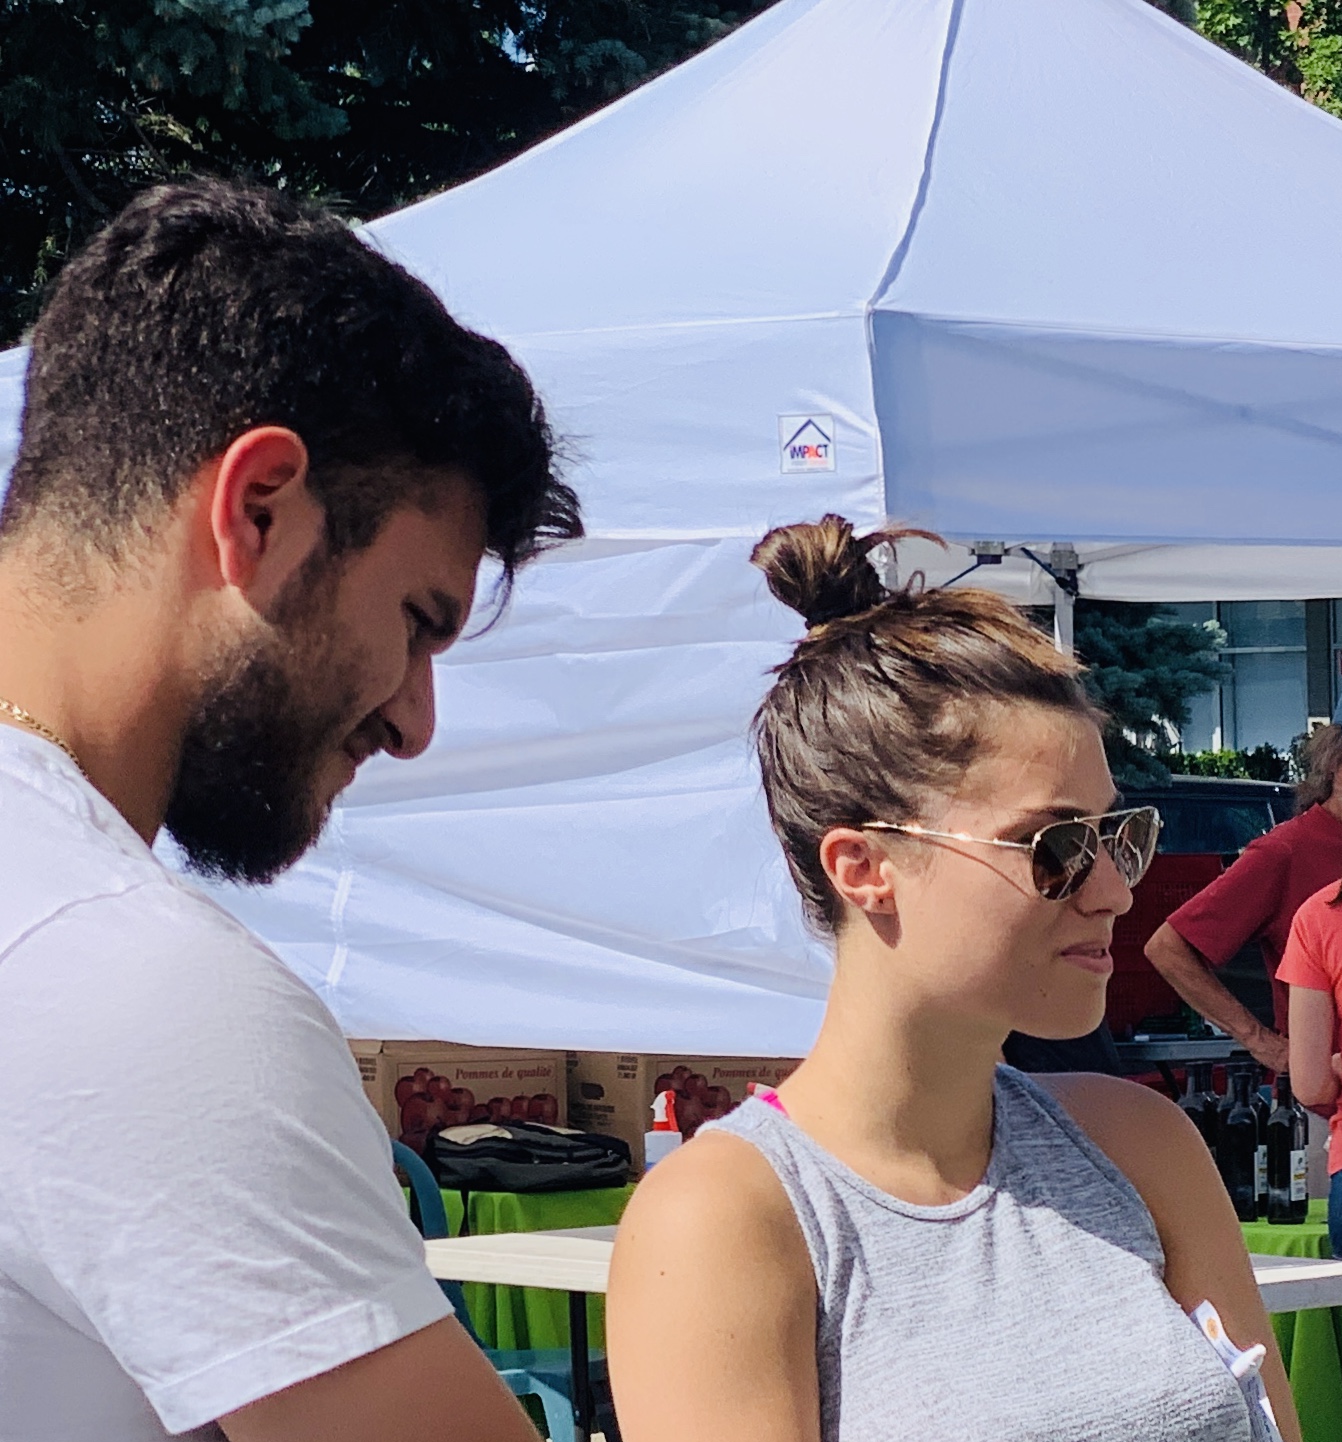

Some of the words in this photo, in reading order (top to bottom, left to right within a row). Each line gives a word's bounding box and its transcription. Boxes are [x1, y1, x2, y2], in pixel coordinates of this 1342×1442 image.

[455, 1067, 499, 1081] Pommes
[502, 1066, 515, 1080] de
[517, 1064, 554, 1081] qualité
[712, 1066, 757, 1079] Pommes
